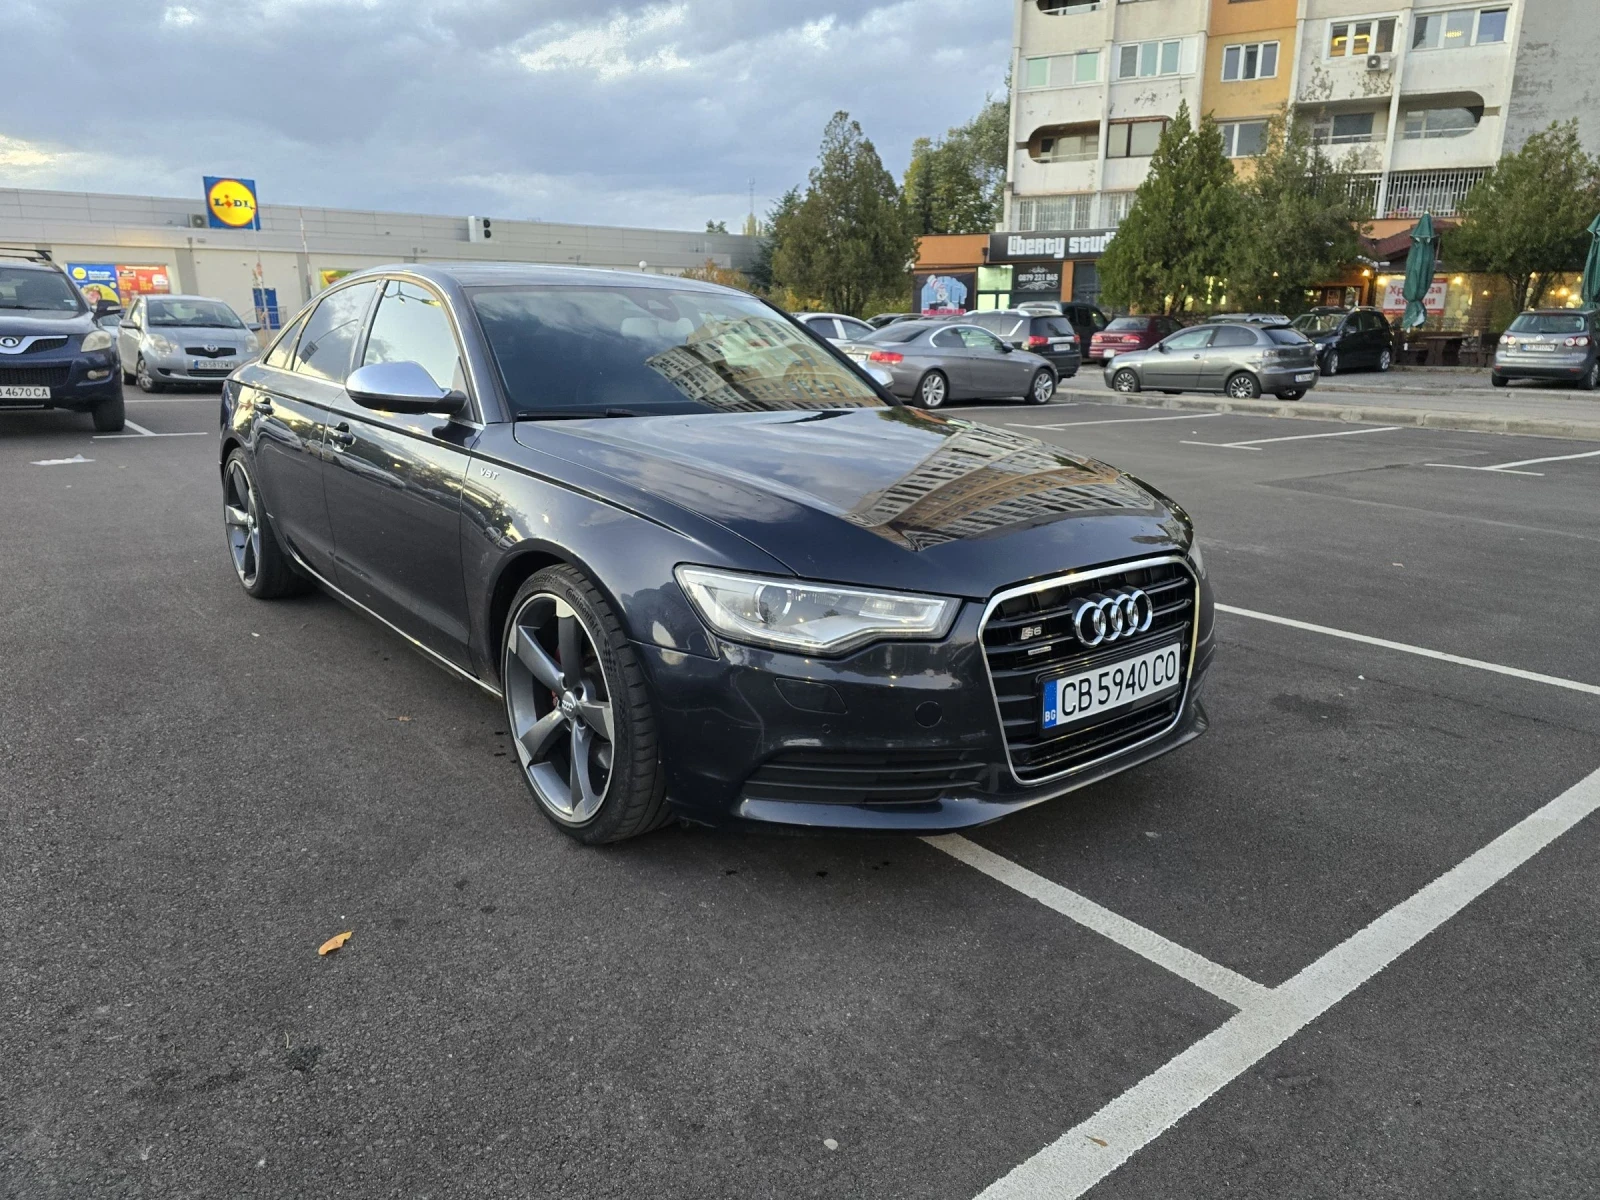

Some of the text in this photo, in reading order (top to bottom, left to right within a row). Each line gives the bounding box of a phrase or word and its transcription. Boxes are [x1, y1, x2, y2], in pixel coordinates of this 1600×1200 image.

[5, 387, 32, 397] 4670
[33, 387, 48, 397] CA
[1061, 650, 1176, 716] CB 5940 CO
[1044, 709, 1057, 722] BG
